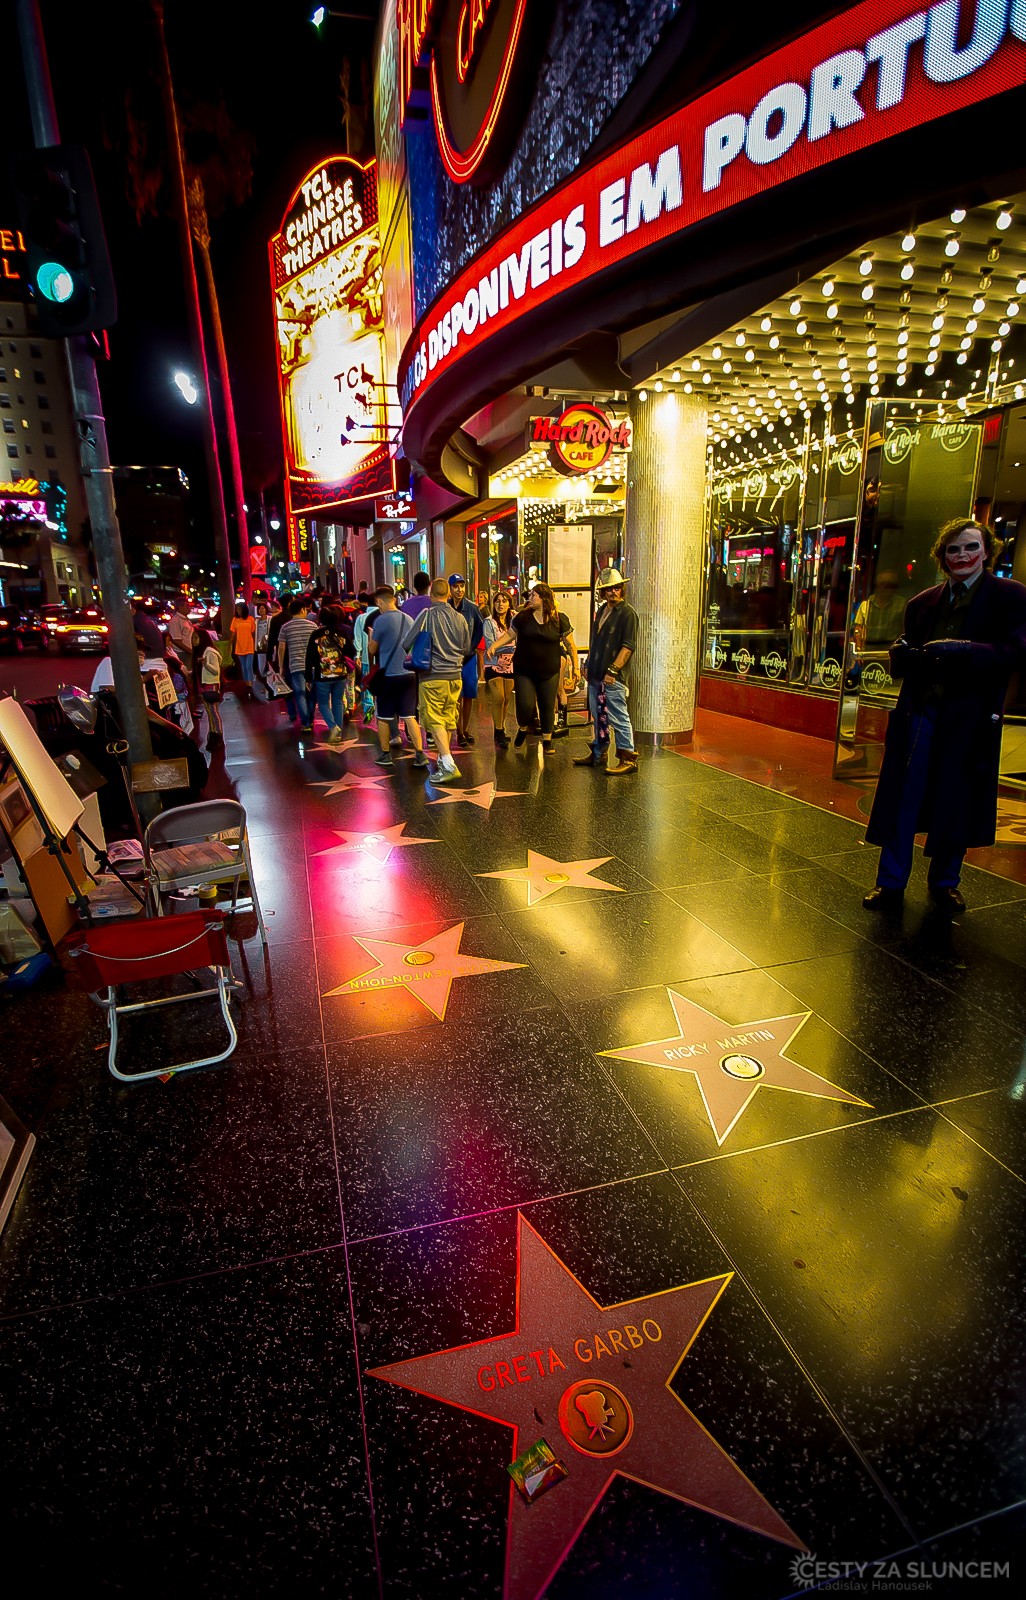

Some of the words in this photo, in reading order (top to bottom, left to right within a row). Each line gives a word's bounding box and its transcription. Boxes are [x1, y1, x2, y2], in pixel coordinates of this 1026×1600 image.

[286, 177, 354, 248] CHINESE
[301, 168, 332, 207] TCL
[428, 203, 587, 371] DISPONIVEIS
[599, 144, 683, 248] EM
[702, 0, 1026, 193] PORTU
[281, 202, 363, 276] THEATRES
[533, 417, 585, 442] Hard
[585, 420, 631, 448] Rock
[569, 451, 594, 461] CAFE
[663, 1042, 710, 1061] RICKY
[715, 1029, 776, 1050] MARTIN
[477, 1347, 567, 1392] GRETA
[574, 1318, 662, 1363] GARBO
